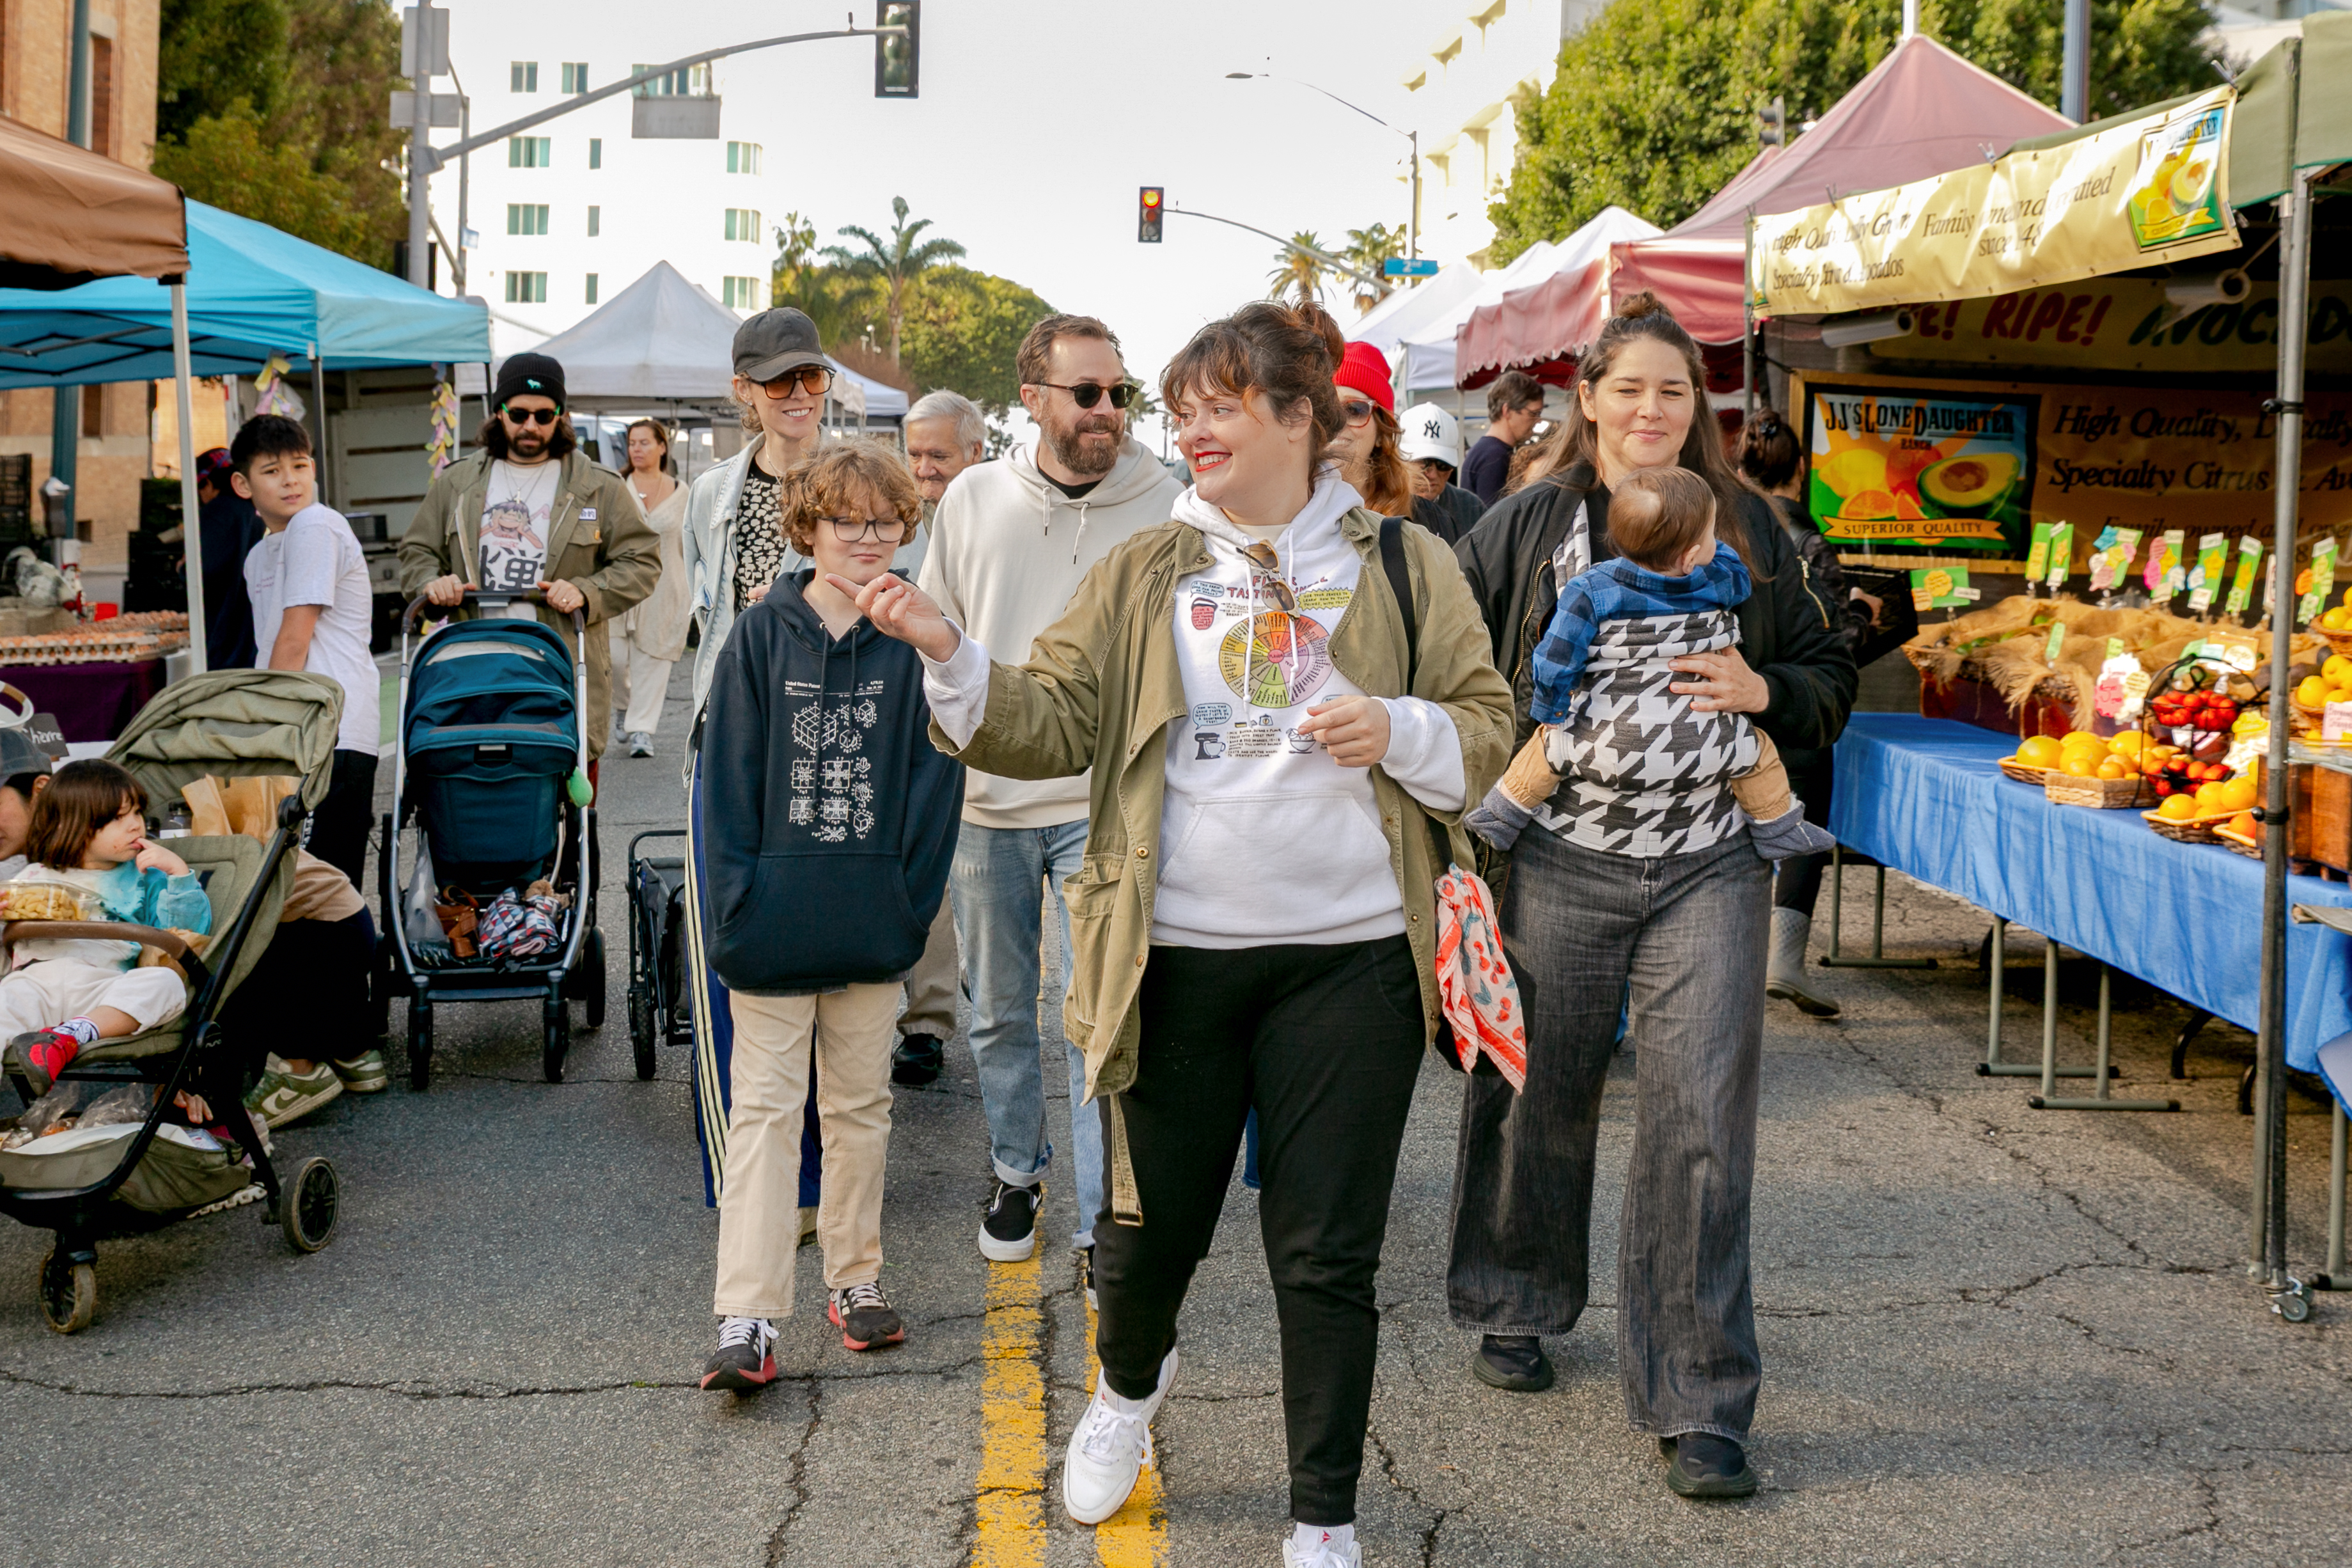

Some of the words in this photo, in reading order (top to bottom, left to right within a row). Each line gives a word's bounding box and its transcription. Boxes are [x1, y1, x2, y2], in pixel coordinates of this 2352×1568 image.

[1922, 208, 1975, 239] Family
[1402, 260, 1422, 273] 2nd
[1982, 292, 2113, 347] RIPE!
[1423, 419, 1440, 439] NY
[1825, 402, 1862, 430] JJ'S
[1863, 403, 1911, 433] LONE
[1912, 405, 2015, 436] DAUGHTER
[2053, 405, 2121, 443] High
[2130, 407, 2241, 444] Quality,
[2048, 459, 2176, 496] Specialty
[2184, 460, 2270, 491] Citrus
[1844, 523, 1915, 535] SUPERIOR
[1922, 521, 1983, 535] QUALITY
